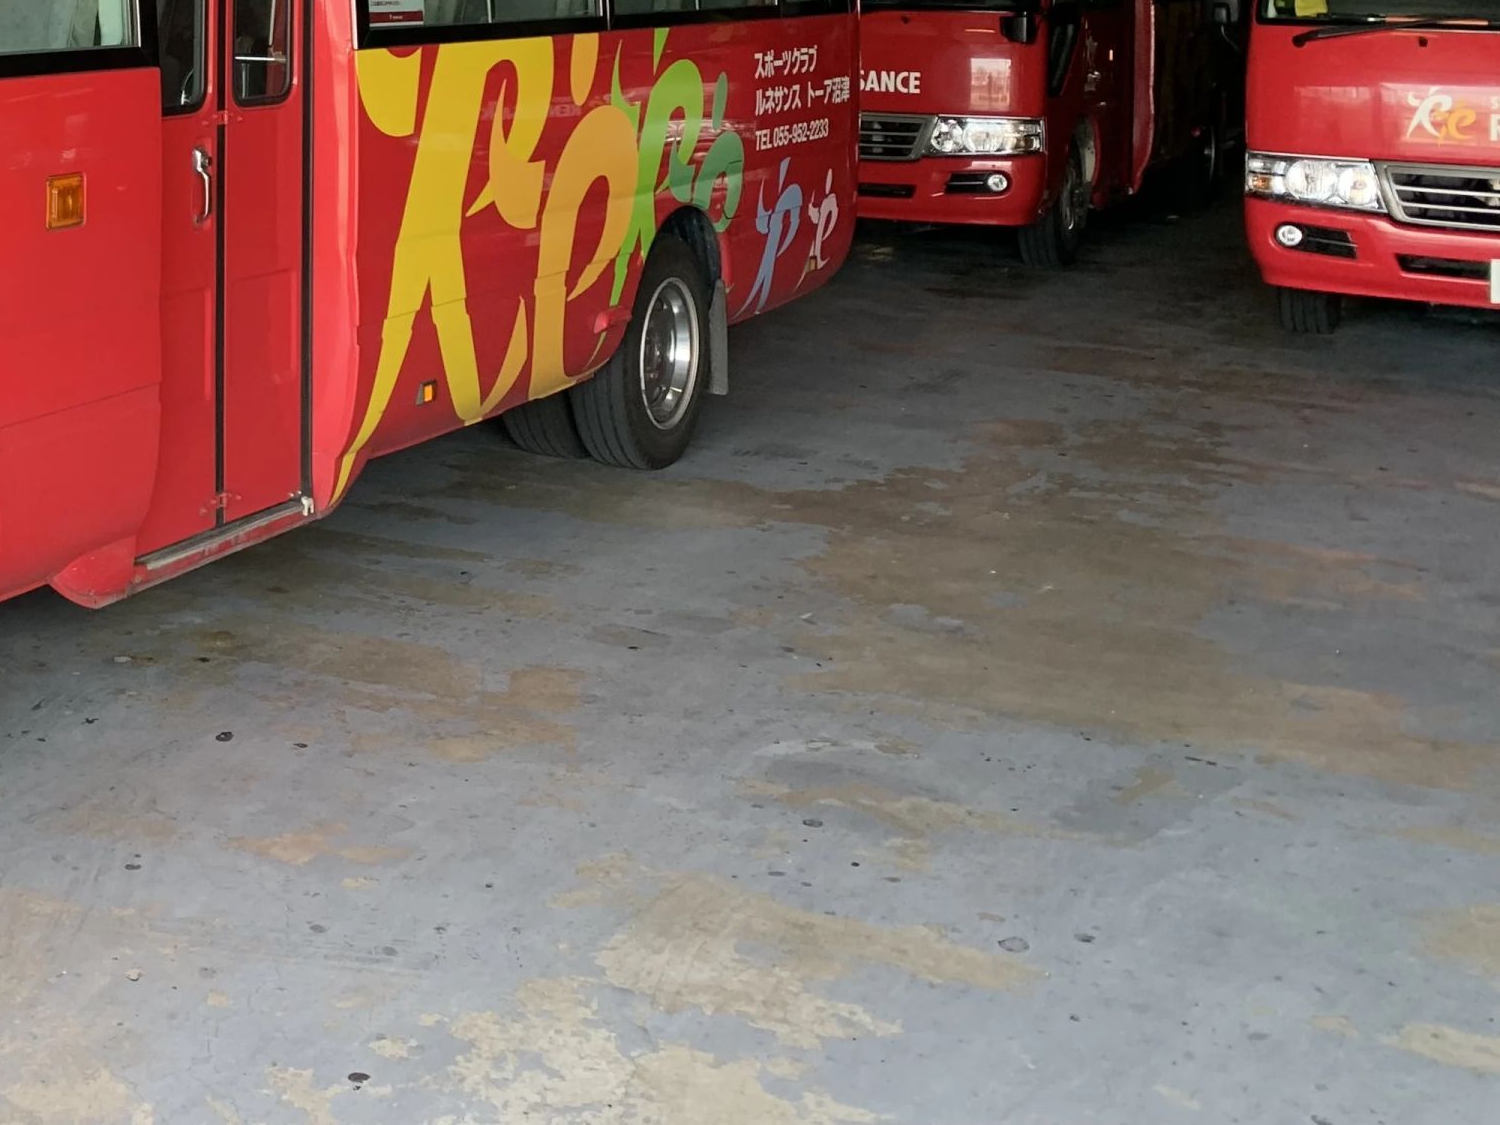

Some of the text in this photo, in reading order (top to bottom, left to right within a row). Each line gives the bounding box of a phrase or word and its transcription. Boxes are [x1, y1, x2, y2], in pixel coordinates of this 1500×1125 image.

[754, 45, 817, 79] スポーツクラブ
[755, 75, 850, 116] ルネサンス トーア沼津
[756, 118, 829, 151] TEL 055-952-2233
